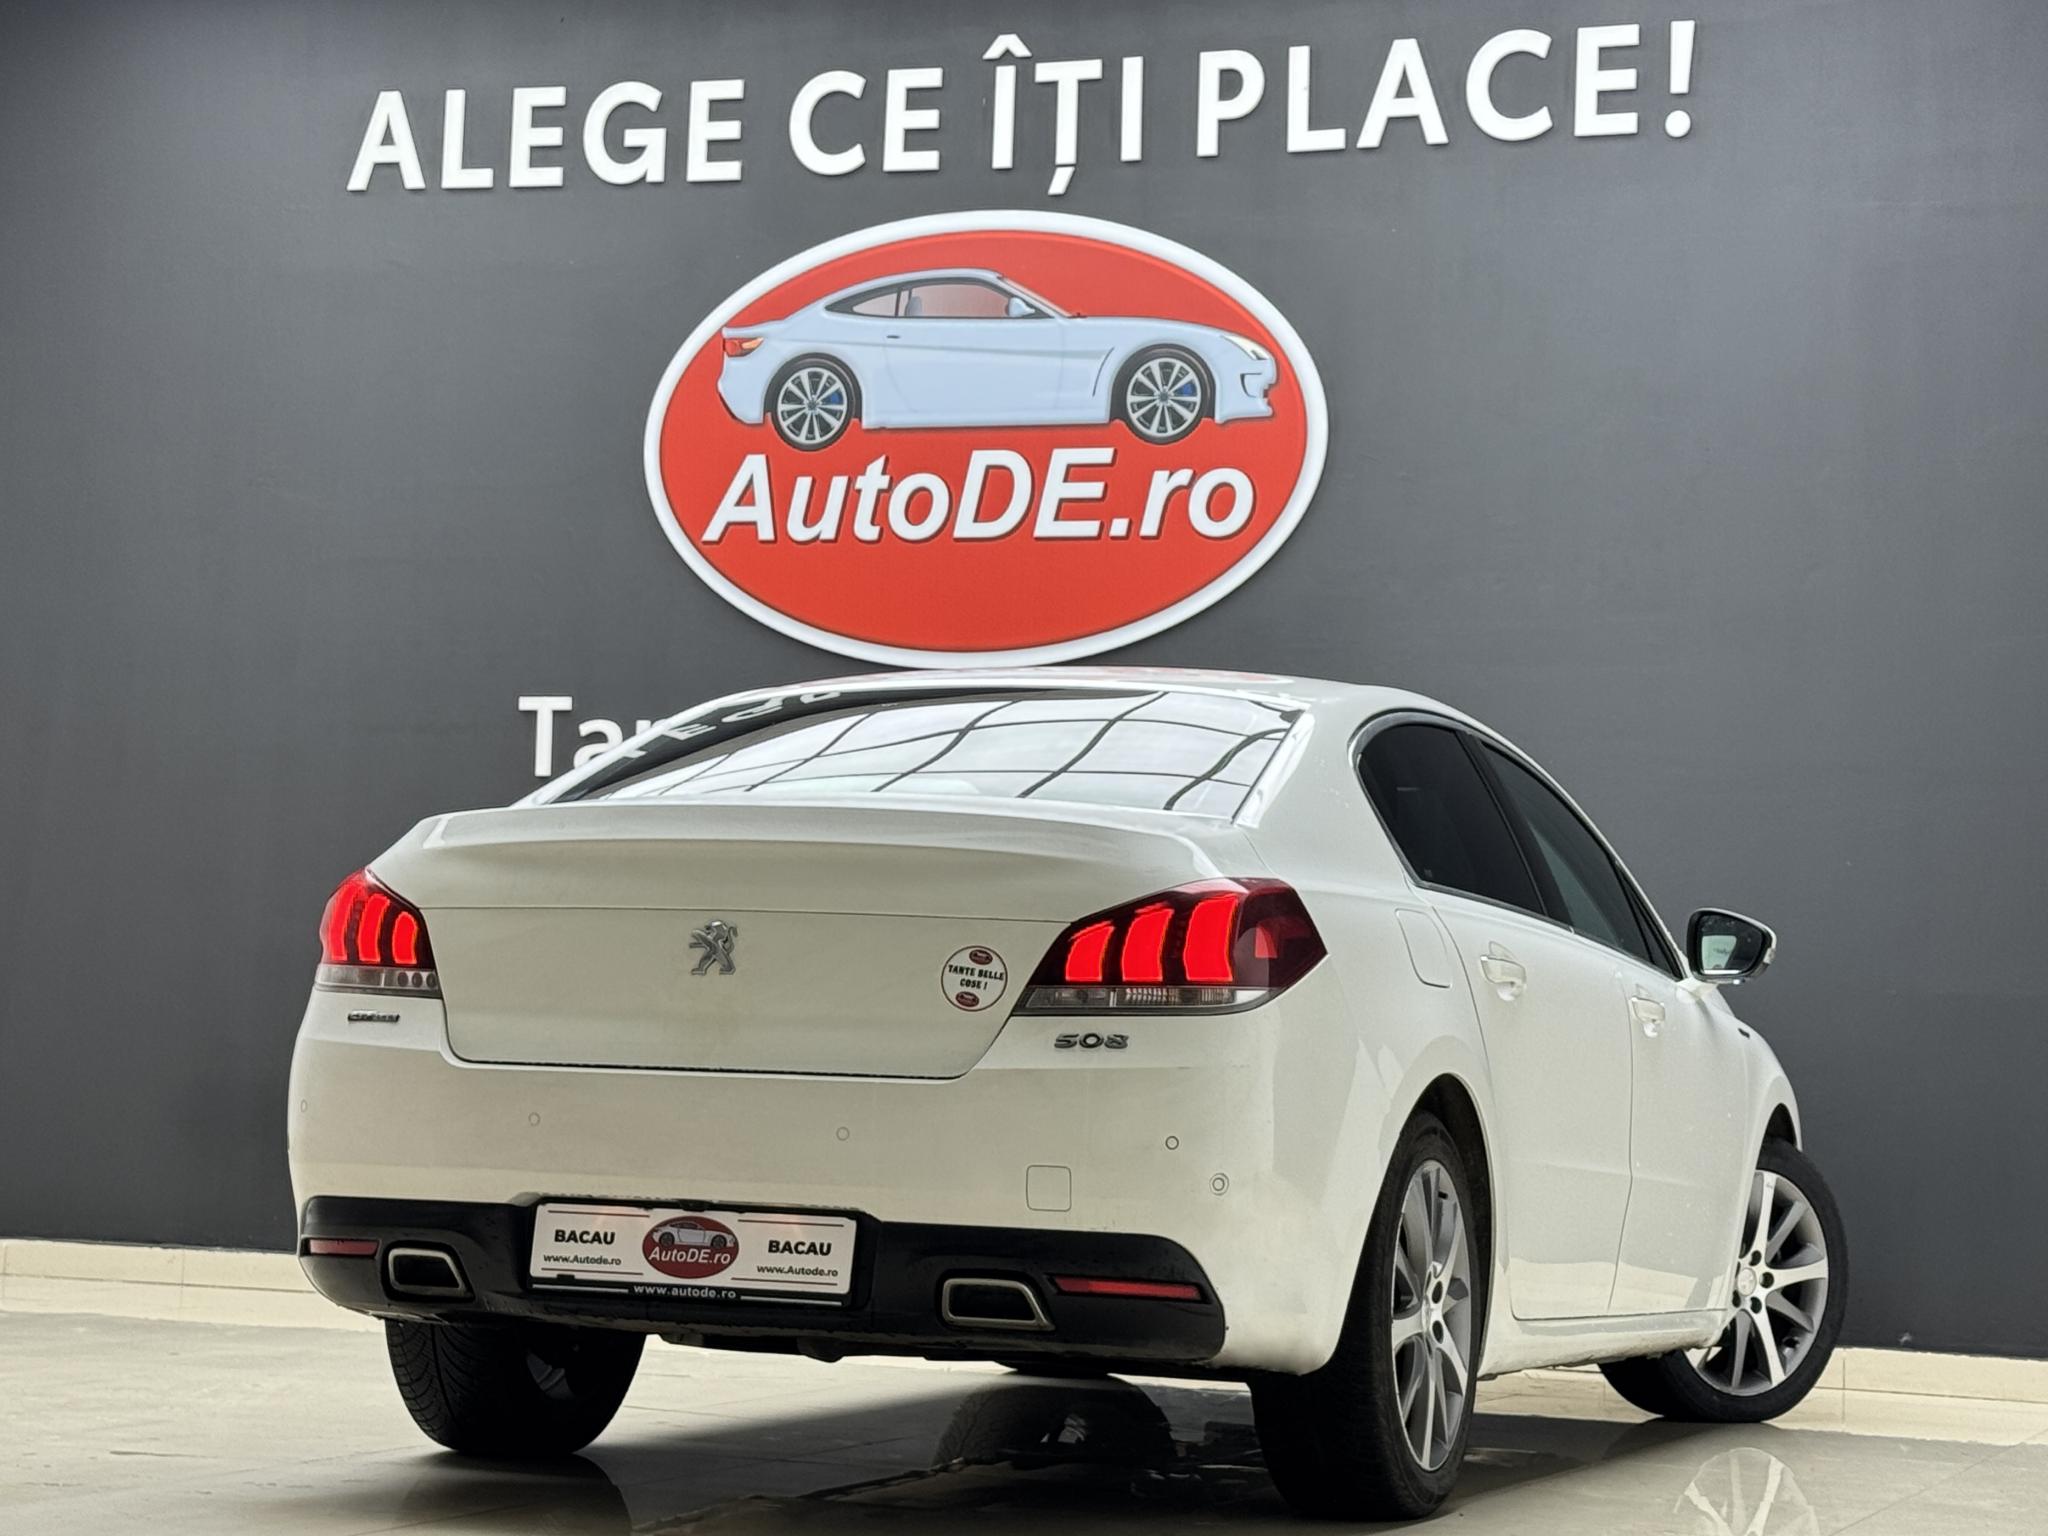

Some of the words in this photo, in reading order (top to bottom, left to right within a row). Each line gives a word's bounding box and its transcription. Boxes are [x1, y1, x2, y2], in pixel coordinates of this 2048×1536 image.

[347, 79, 745, 191] ALEGE
[788, 67, 944, 176] CE
[1197, 19, 1696, 159] PLACE!
[702, 446, 1256, 542] AutoDE.ro
[948, 964, 976, 977] TANTE
[978, 968, 1004, 981] BELLE
[1054, 1032, 1129, 1050] 508
[553, 1229, 616, 1246] BACAU
[648, 1246, 731, 1266] AutoDE.ro
[767, 1239, 832, 1257] BACAU
[543, 1252, 622, 1266] www.Autode.ro
[756, 1263, 839, 1278] www.Autode.ro
[633, 1283, 737, 1300] www.autode.ro
